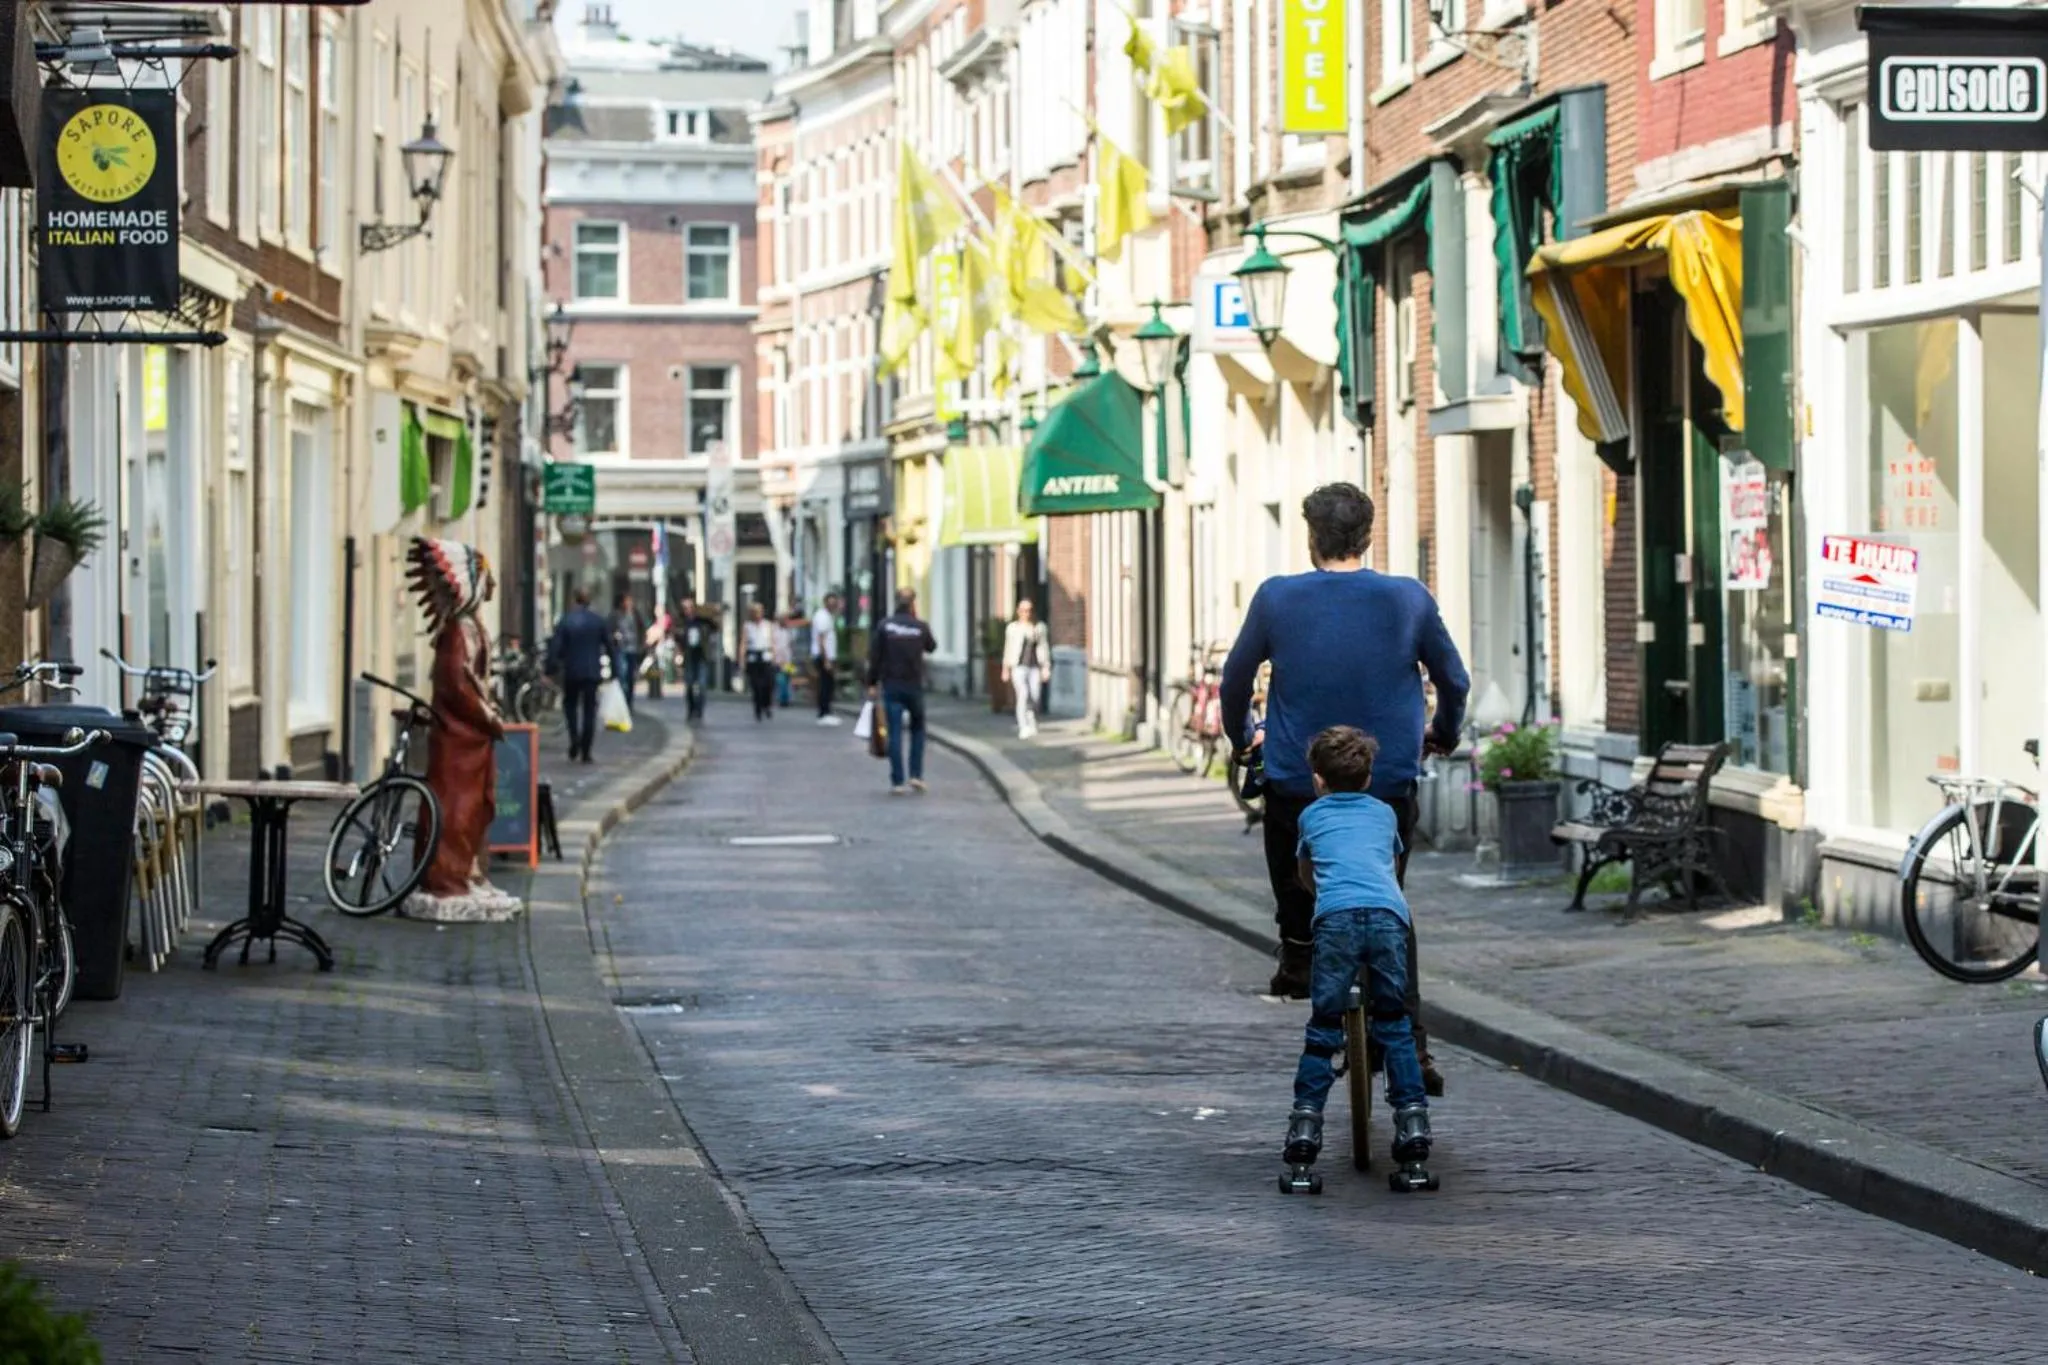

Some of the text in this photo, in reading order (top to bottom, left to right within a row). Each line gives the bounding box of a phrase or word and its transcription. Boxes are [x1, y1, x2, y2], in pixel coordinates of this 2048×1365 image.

[1895, 64, 2030, 112] episode
[66, 110, 147, 142] SAPORE
[48, 210, 168, 227] HOMEMADE
[48, 229, 168, 245] ITALIAN FOOD
[65, 296, 152, 306] WWW.SAPORE.NL
[1042, 474, 1119, 495] ANTIEK
[1826, 539, 1914, 572] TE HUUR
